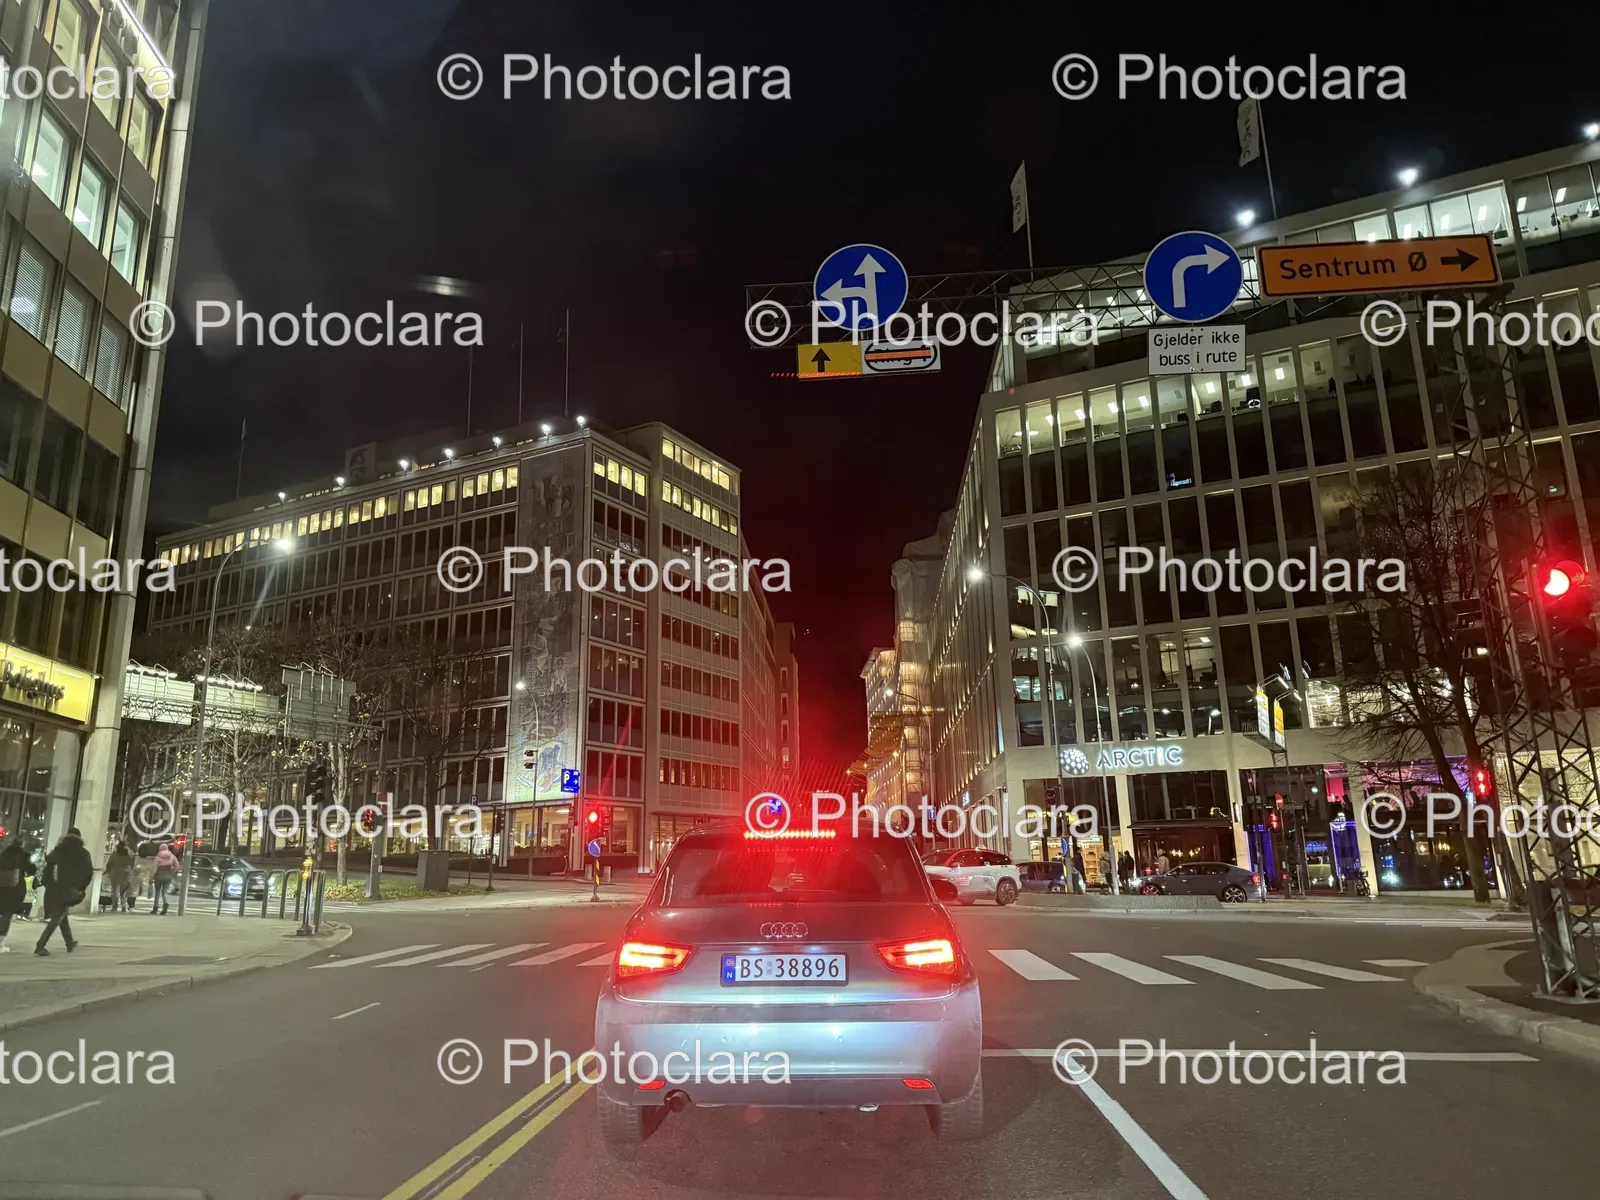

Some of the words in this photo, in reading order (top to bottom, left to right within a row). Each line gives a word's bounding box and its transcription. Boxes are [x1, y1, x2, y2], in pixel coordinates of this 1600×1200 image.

[1280, 257, 1396, 280] Sentrum
[1408, 251, 1428, 272] Ø
[1153, 332, 1203, 349] Gjelder
[1211, 331, 1240, 344] ikke
[1159, 353, 1191, 366] buss
[1196, 351, 1200, 364] i
[1206, 351, 1237, 363] rute
[1097, 747, 1182, 768] ARCTIC
[564, 773, 570, 784] P
[740, 958, 763, 978] BS
[775, 958, 839, 978] 38896
